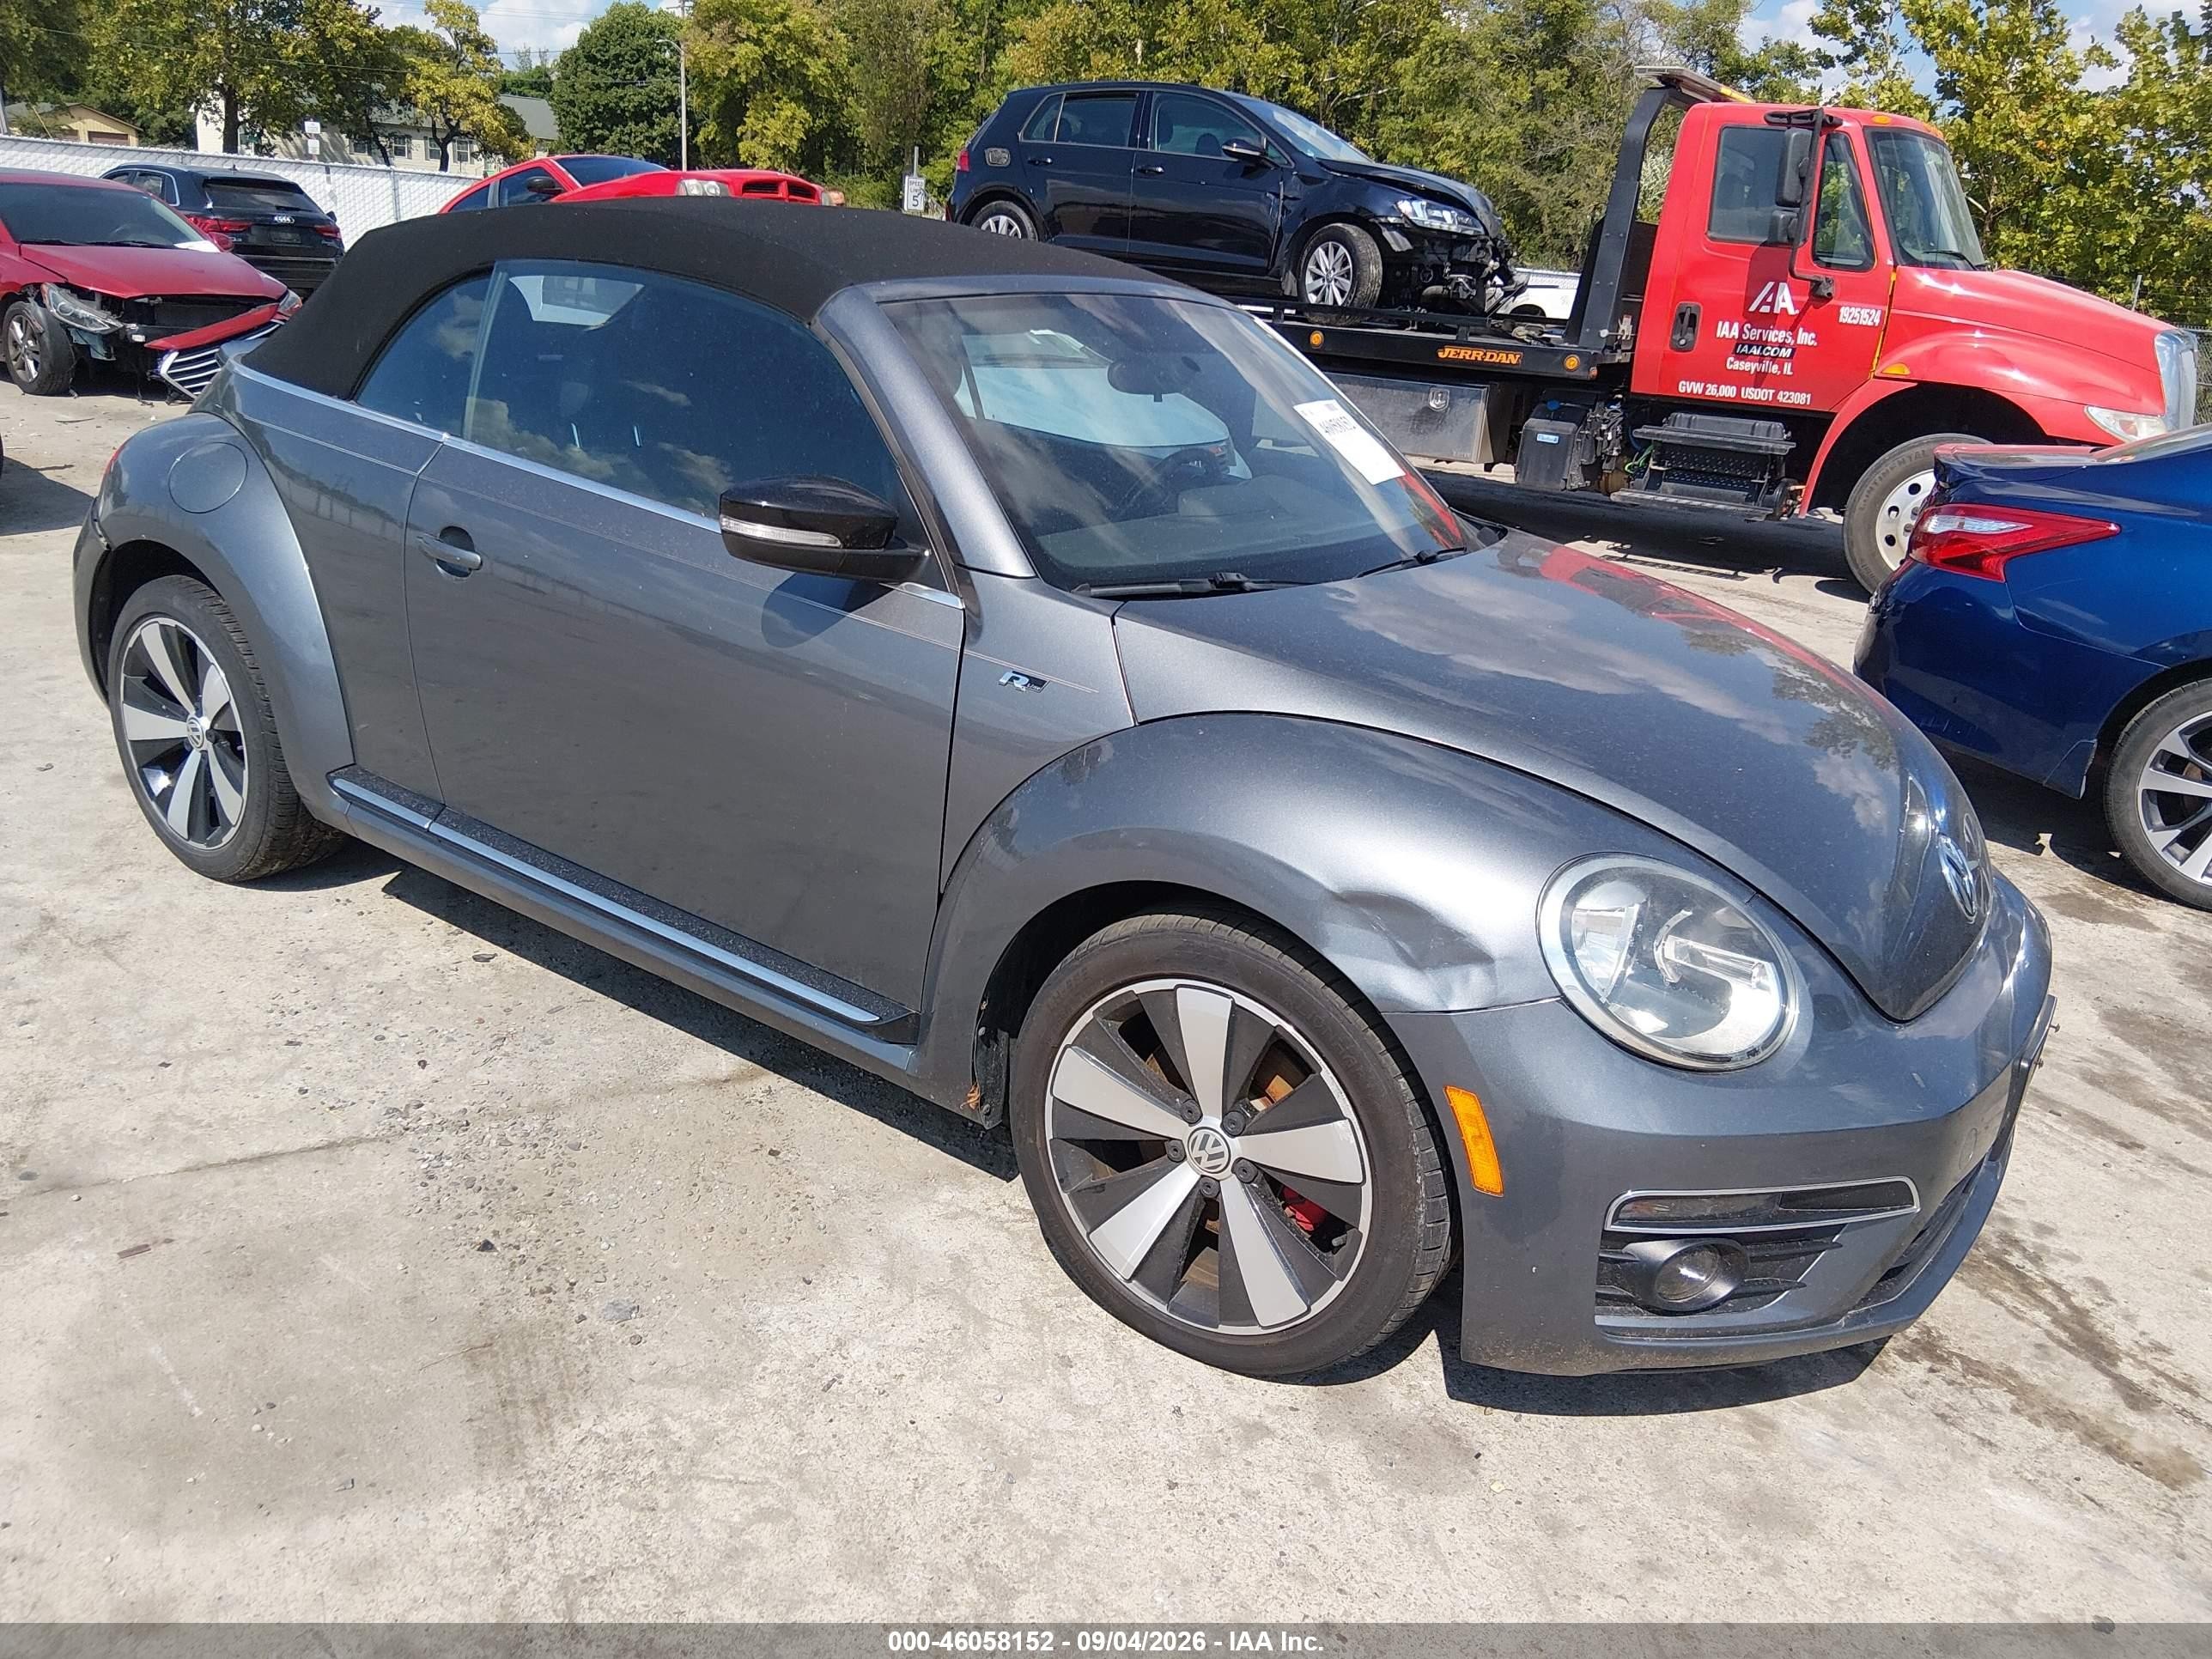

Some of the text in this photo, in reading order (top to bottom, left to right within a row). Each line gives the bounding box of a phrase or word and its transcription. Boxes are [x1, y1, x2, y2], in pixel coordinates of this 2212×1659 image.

[912, 195, 919, 207] 5
[1838, 306, 1882, 327] 19251524
[1716, 320, 1818, 347] IAA Services, Inc.
[1726, 356, 1794, 375] Caseyville, IL
[1678, 380, 1811, 405] GVW 26,000 USDOT 423081
